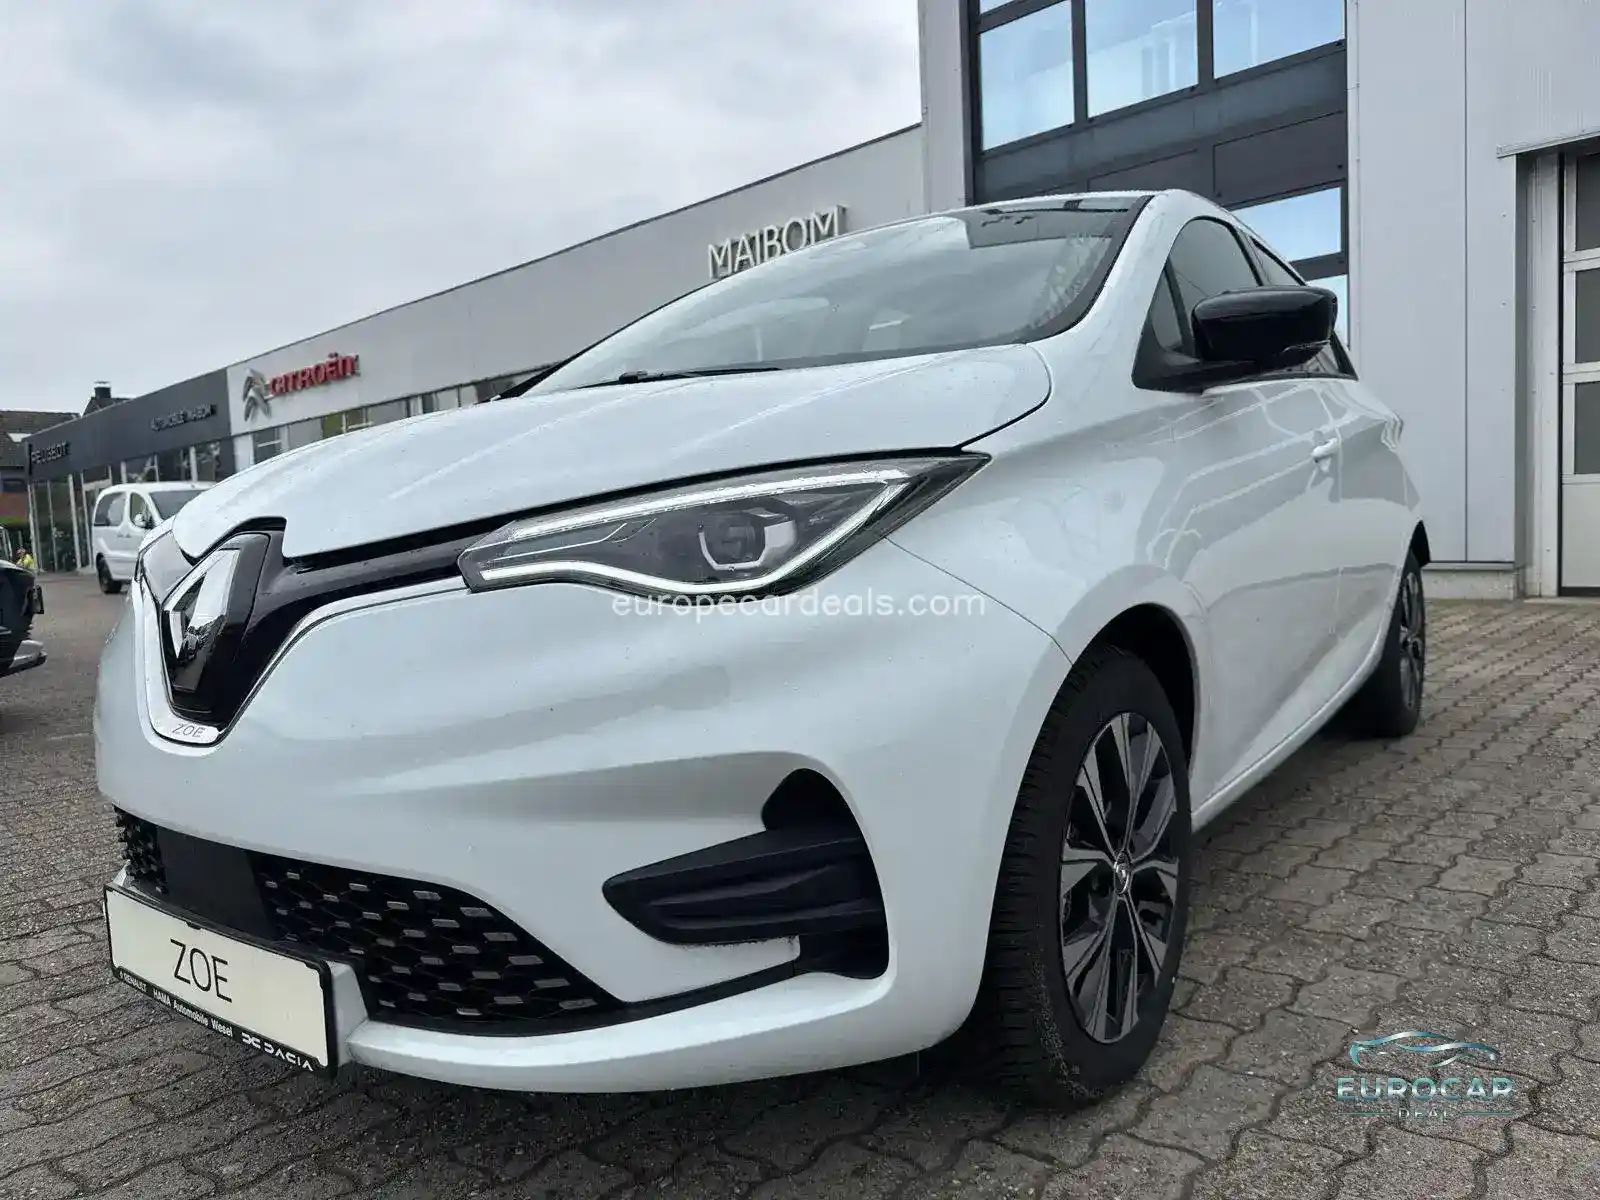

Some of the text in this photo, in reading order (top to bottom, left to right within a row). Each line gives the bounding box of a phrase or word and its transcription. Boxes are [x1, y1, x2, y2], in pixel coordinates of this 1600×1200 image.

[708, 203, 847, 280] MAIBOM
[172, 723, 206, 738] ZOE
[170, 938, 233, 1003] ZOE
[173, 999, 209, 1027] Automobile
[211, 1018, 233, 1038] Wesel
[264, 1041, 314, 1072] DACIA
